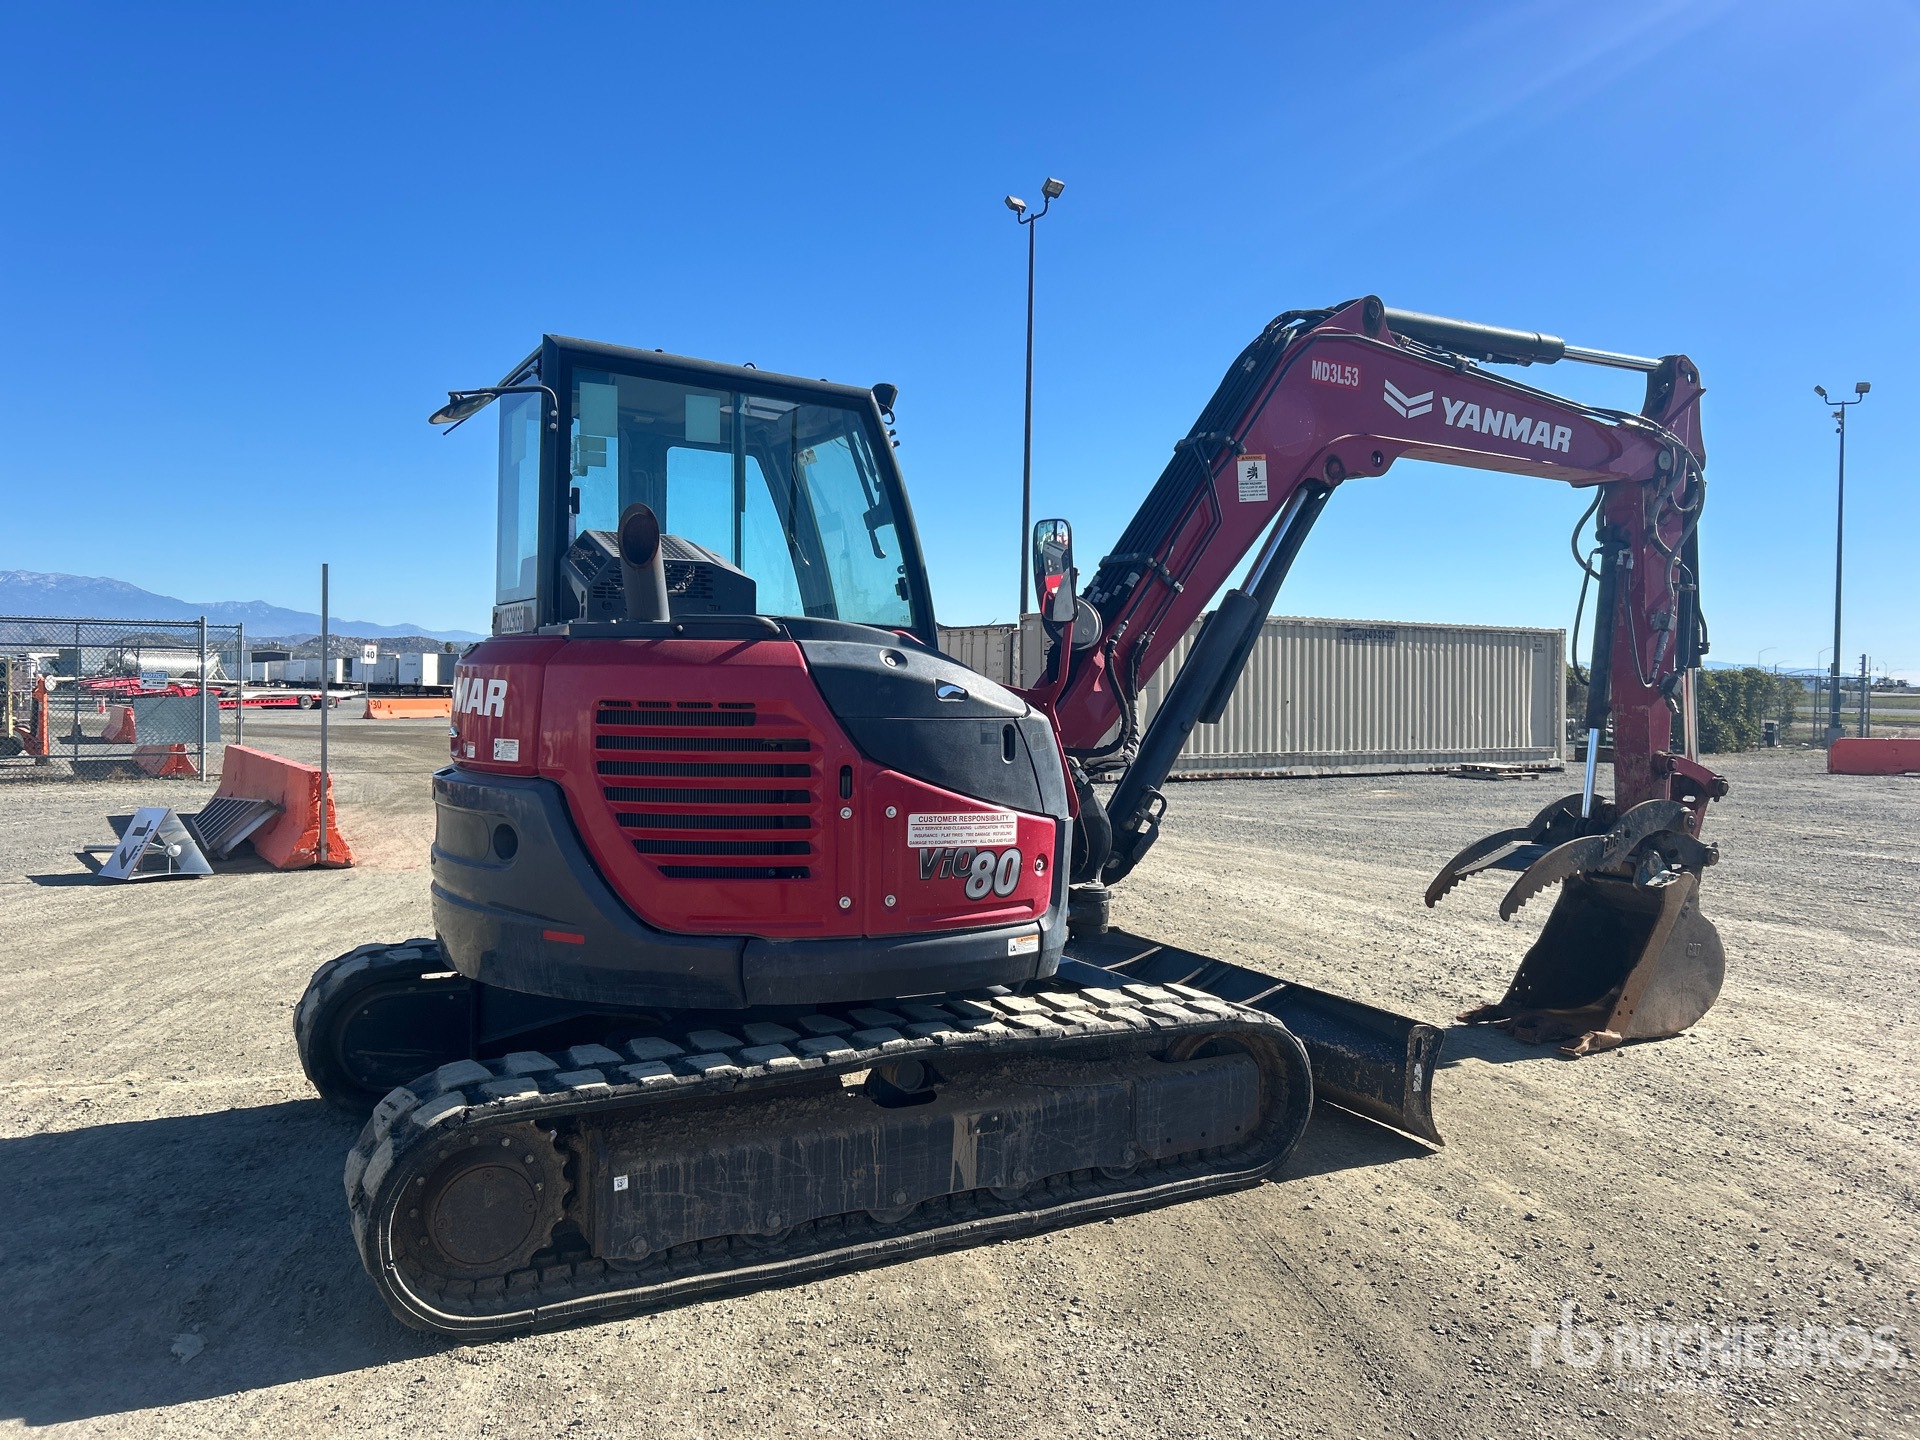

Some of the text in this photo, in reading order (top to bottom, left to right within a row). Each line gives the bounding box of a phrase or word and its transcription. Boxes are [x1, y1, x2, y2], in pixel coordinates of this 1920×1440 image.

[1312, 360, 1359, 387] MD3L53
[1442, 396, 1573, 453] YANMAR
[366, 651, 375, 659] 40
[918, 814, 1009, 823] CUSTOMER RESPONSIBILITY
